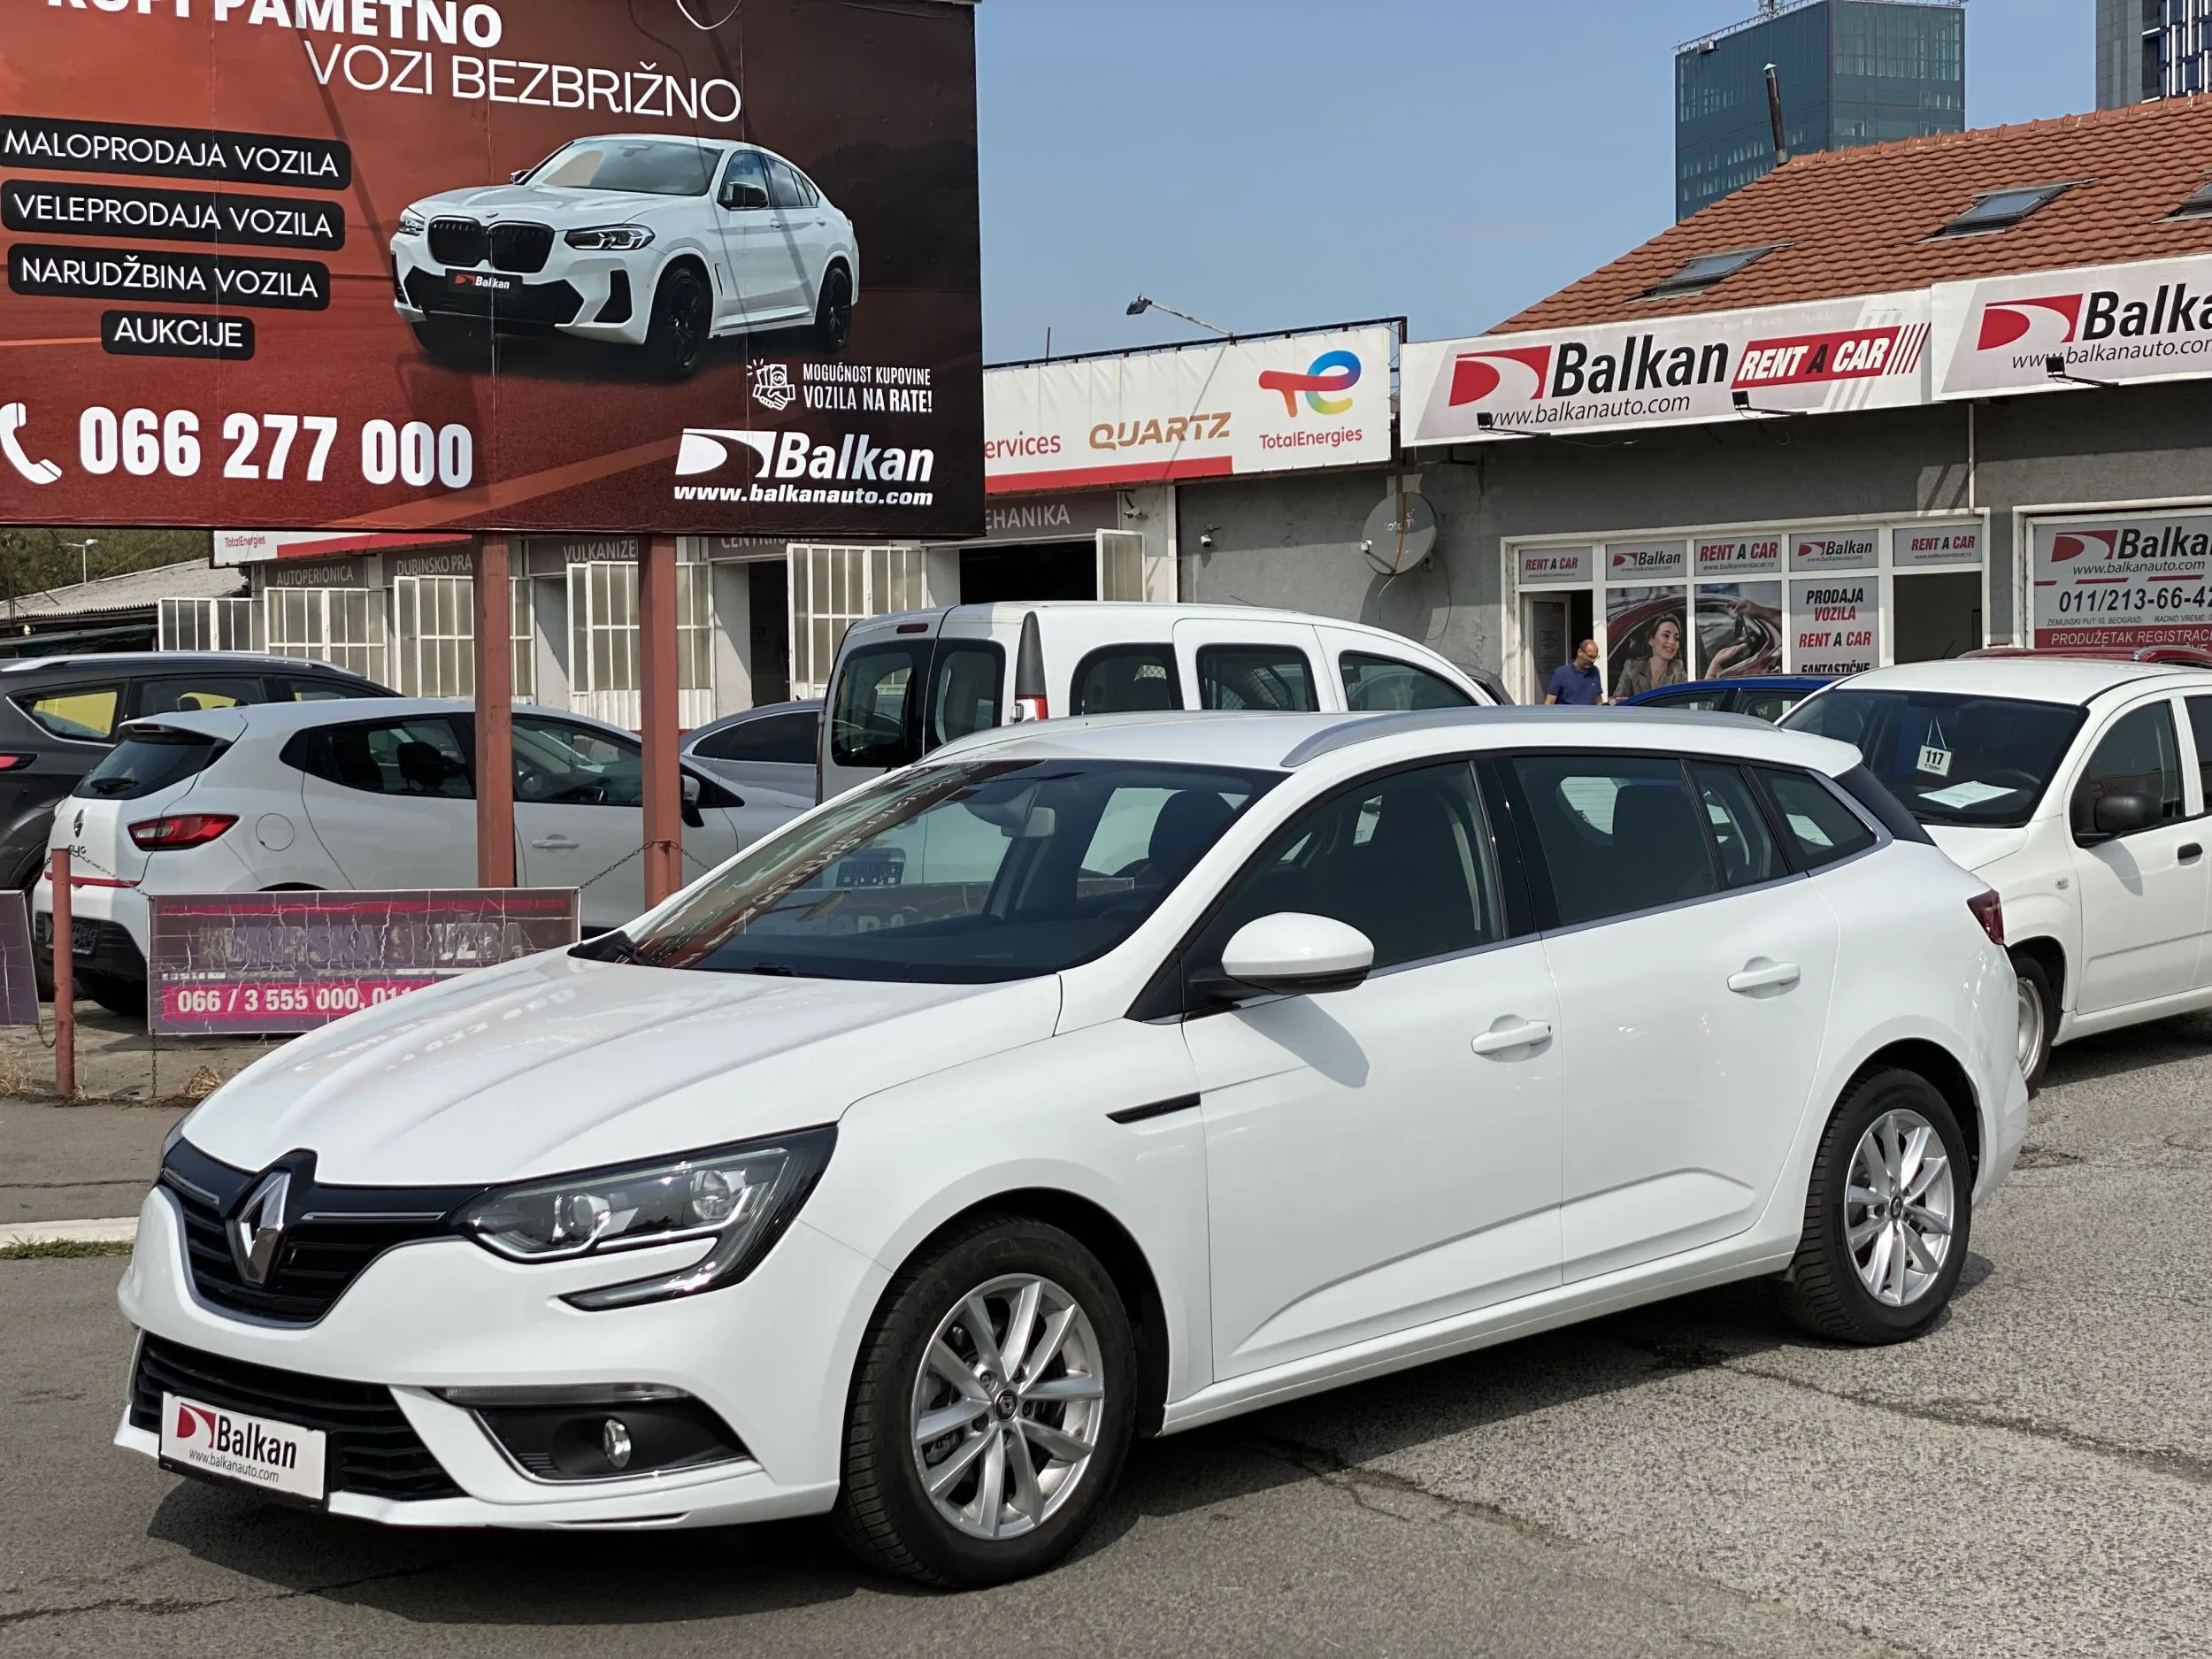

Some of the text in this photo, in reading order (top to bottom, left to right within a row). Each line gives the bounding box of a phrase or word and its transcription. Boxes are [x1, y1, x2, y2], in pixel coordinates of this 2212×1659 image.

[303, 40, 741, 123] VOZI BEZBRIŽNO
[4, 129, 339, 178] MALOPRODAJA VOZILA
[13, 193, 334, 238] VELEPRODAJA VOZILA
[22, 255, 319, 298] NARUDŽBINA VOZILA
[475, 275, 511, 289] Balkan
[113, 317, 243, 348] AUKCIJE
[1550, 333, 1732, 398] Balkan
[1738, 337, 1890, 380] RENT A CAR
[803, 361, 931, 386] MOGUĆNOST KUPOVINE
[803, 385, 933, 413] VOZILA NA RATE!
[1089, 411, 1233, 451] QUARTZ
[1259, 426, 1363, 449] TotalEnergies
[80, 406, 473, 488] 066 277 000
[775, 431, 934, 482] Balkan
[673, 483, 933, 506] www.balkanauto.com
[225, 534, 266, 549] TotalEnergies
[1700, 541, 1778, 562] RENT A CAR
[1825, 540, 1873, 556] Balkan
[1911, 534, 1976, 551] RENT A CAR
[2117, 526, 2212, 559] Balka
[396, 555, 449, 576] DUBINSKO
[1525, 557, 1578, 571] RENT A CAR
[1638, 550, 1681, 565] Balkan
[2073, 559, 2206, 575] www.balkanauto.com
[276, 565, 354, 587] AUTOPERIONICA
[1806, 588, 1863, 605] PRODAJA
[1814, 605, 1856, 621] VOZILA
[1799, 631, 1872, 648] RENT A CAR
[2051, 630, 2134, 645] PRODUŽETAK
[1925, 749, 1945, 765] 117
[178, 989, 221, 1012] 066
[227, 988, 239, 1012] /
[244, 989, 259, 1012] 3
[266, 988, 308, 1011] 555
[217, 1414, 297, 1470] Balkan
[188, 1448, 280, 1484] www.balkanauto.com
